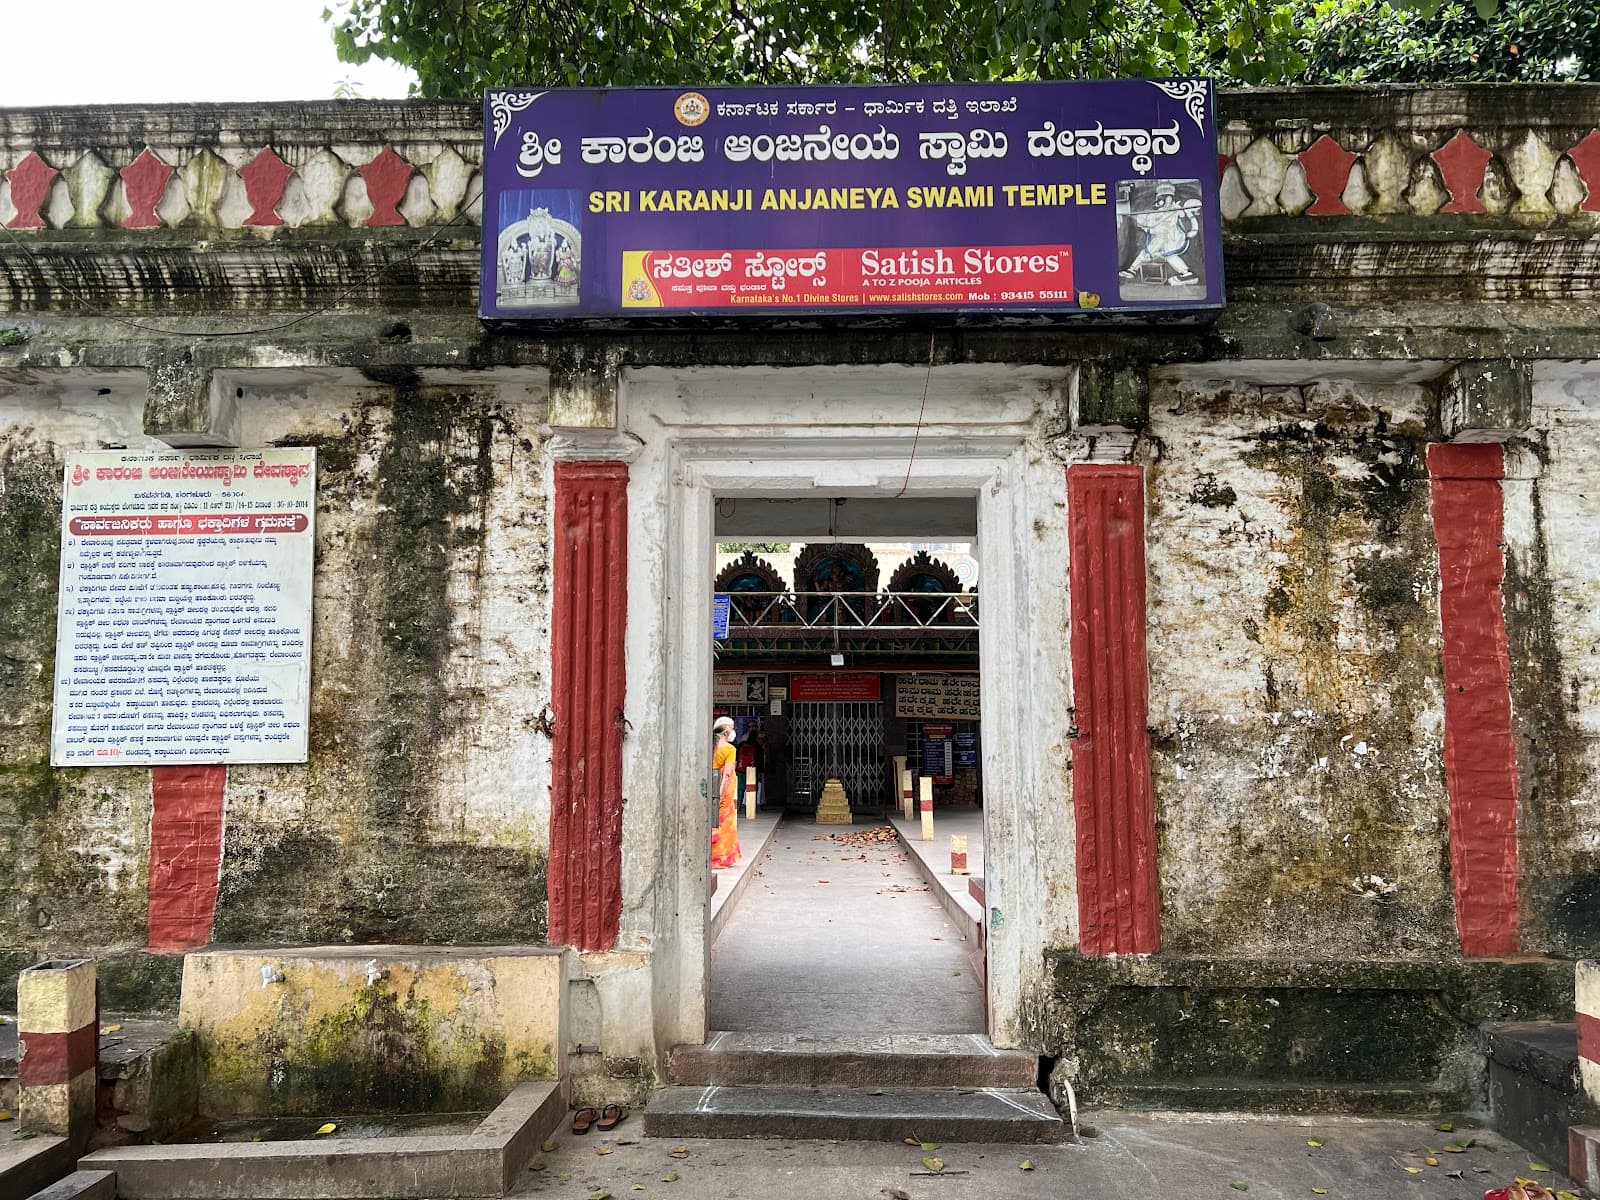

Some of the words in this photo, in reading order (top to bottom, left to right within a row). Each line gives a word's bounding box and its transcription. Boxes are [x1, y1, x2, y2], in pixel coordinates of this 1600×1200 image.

[717, 101, 779, 116] ಕರ್ನಾಟಕ
[787, 100, 836, 115] ಸರ್ಕಾರ
[864, 99, 924, 117] ಧಾರ್ಮಿಕ
[933, 98, 959, 119] ದತ್ತಿ
[966, 97, 1017, 114] ಇಲಾಖೆ
[516, 130, 561, 177] ಶ್ರೀ
[581, 128, 704, 163] ಕಾರಂಜಿ
[724, 125, 899, 161] ಆಂಜನೇಯ
[919, 129, 1008, 175] ಸ್ವಾಮಿ
[1028, 119, 1180, 175] ದೇವಸ್ಥಾನ
[589, 191, 630, 213] SRI
[640, 189, 752, 212] KARANJI
[761, 187, 899, 210] ANJANEYA
[907, 186, 993, 208] SWAMI
[1002, 184, 1106, 206] TEMPLE
[654, 252, 732, 278] ಸತೀಶ್
[862, 249, 955, 276] Satish
[964, 249, 1059, 274] Stores
[898, 278, 931, 287] POOJA
[935, 277, 982, 285] ARTICLES
[730, 294, 780, 303] Karnataka's
[782, 294, 800, 303] No.1
[804, 293, 829, 302] Divine
[832, 294, 859, 302] Stores
[869, 292, 963, 302] www.satishstores.com
[969, 292, 990, 300] Mob
[1001, 291, 1034, 300] 93415
[1039, 291, 1067, 299] 55111
[157, 517, 192, 530] ಹಾಗೂ
